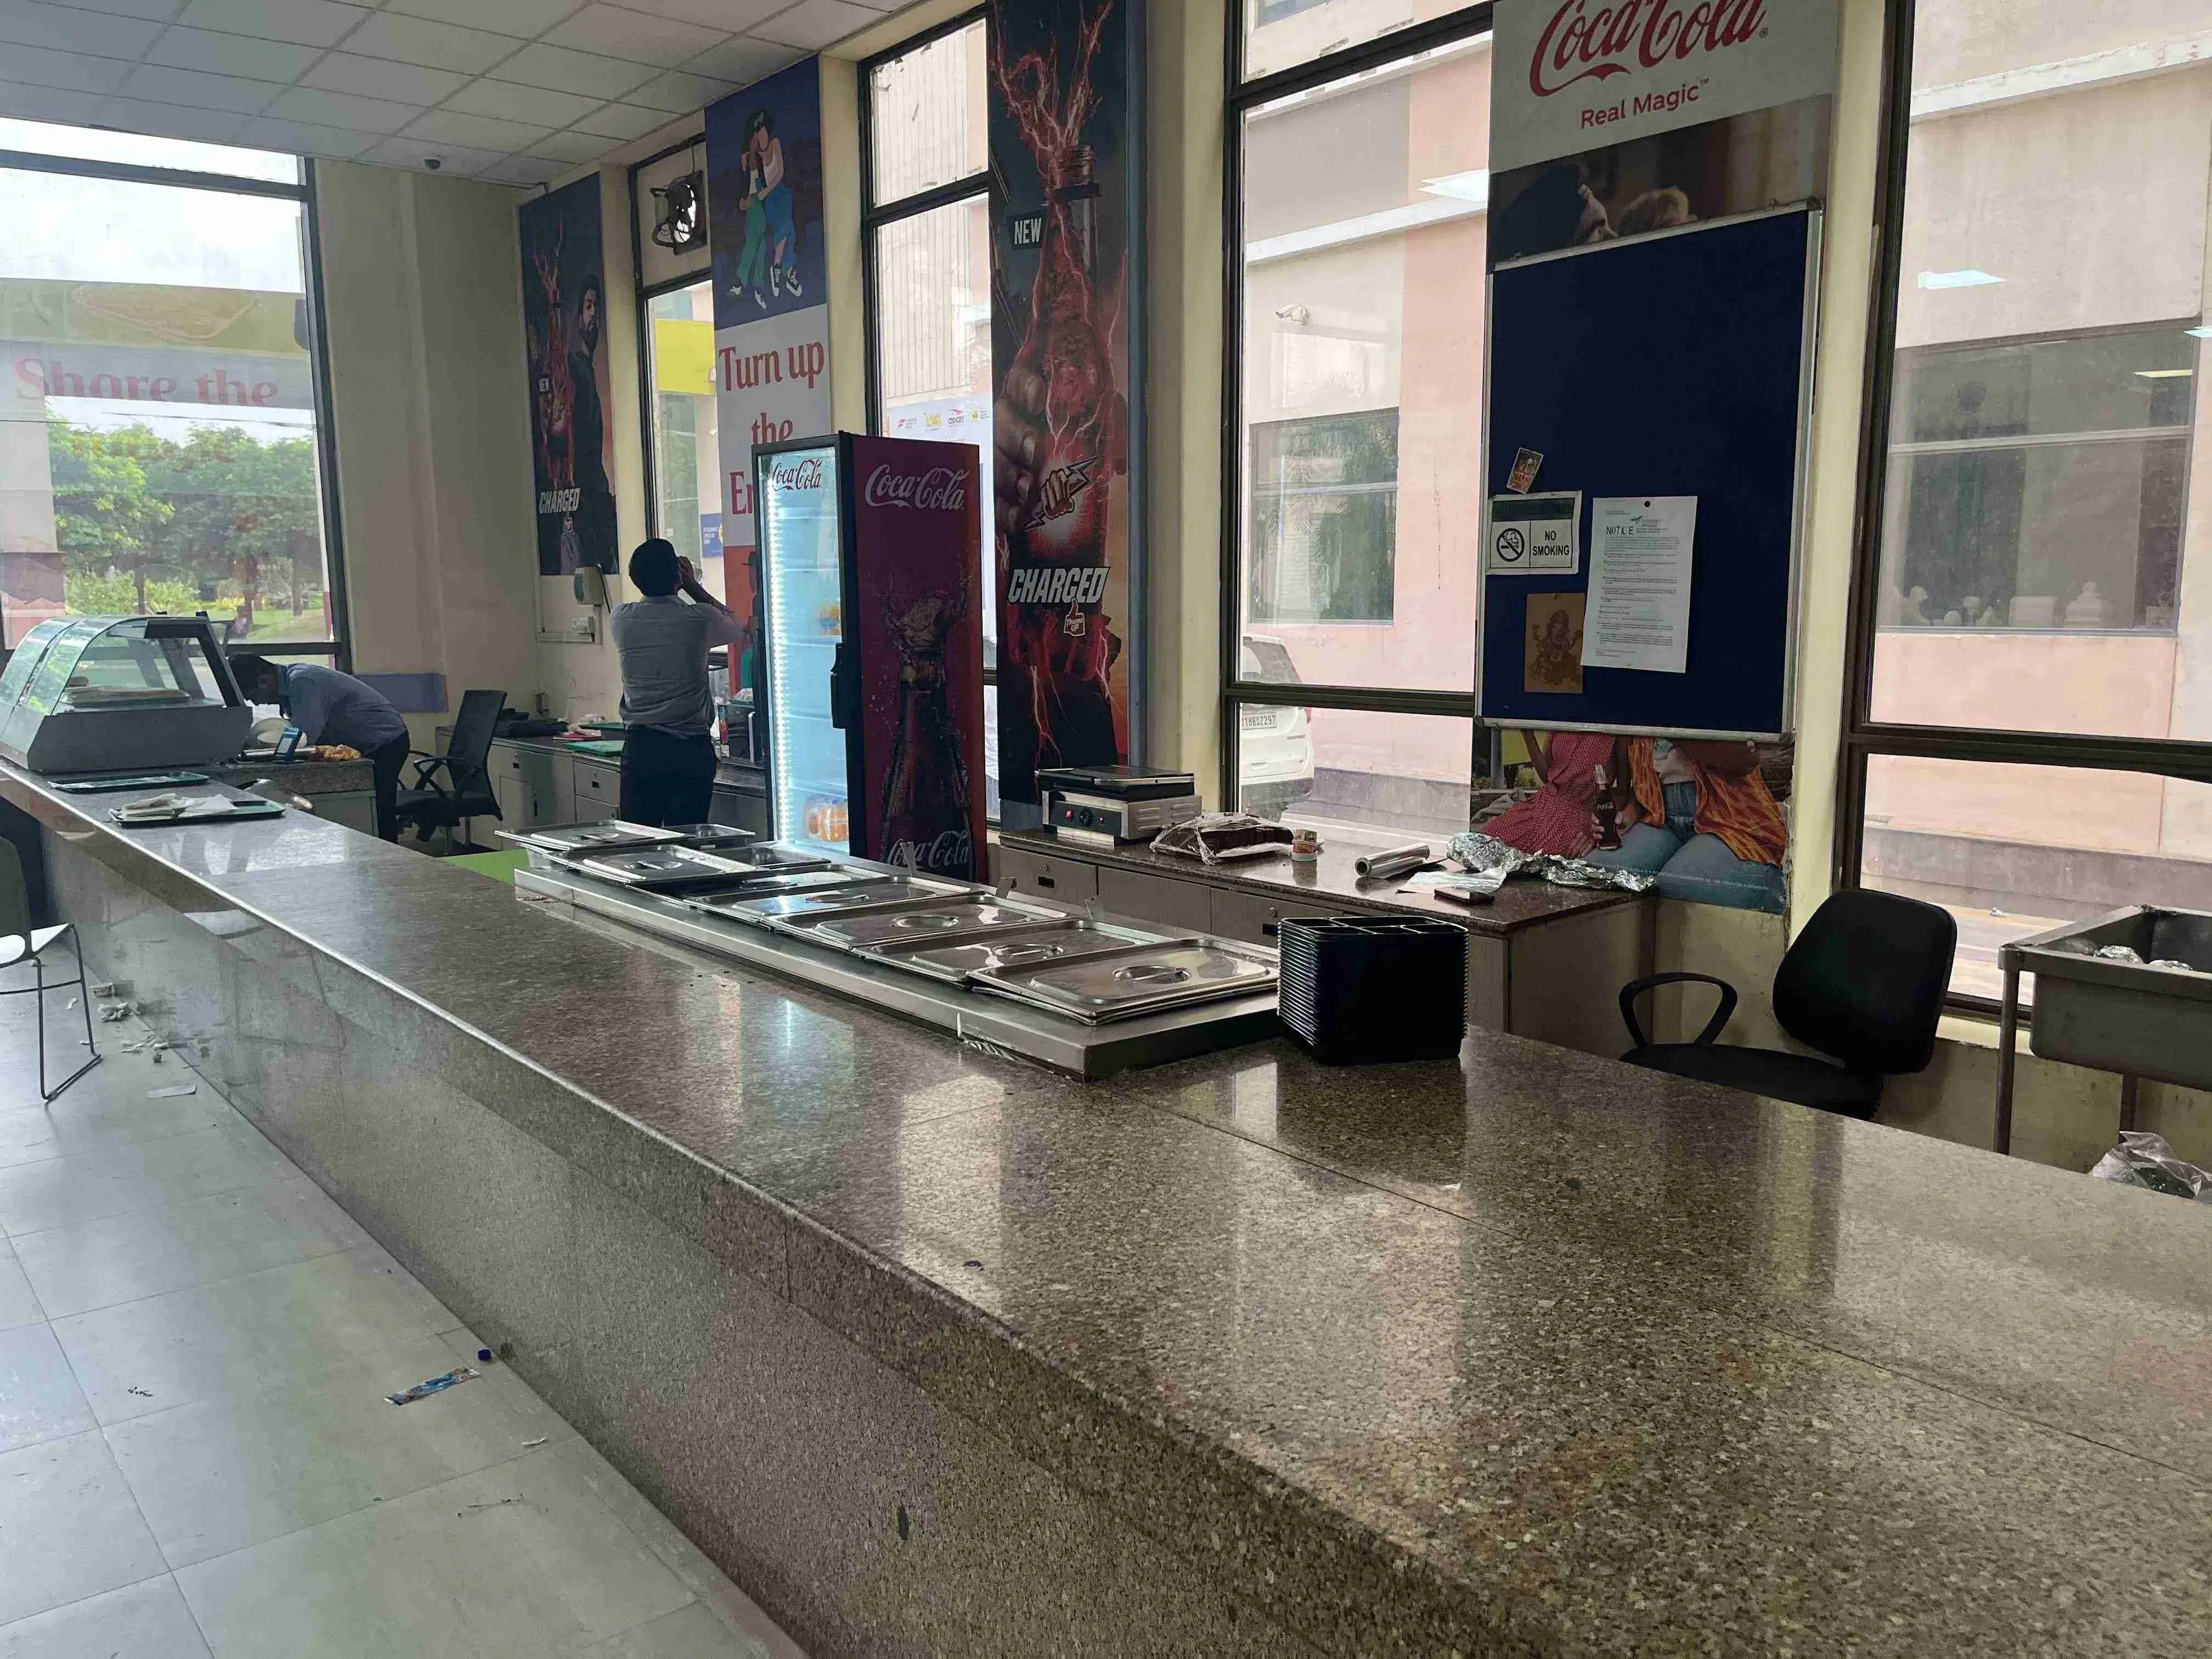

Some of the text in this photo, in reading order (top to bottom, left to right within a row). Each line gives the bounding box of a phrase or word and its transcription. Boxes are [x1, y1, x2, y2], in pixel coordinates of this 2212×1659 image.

[1530, 0, 1766, 97] CocaCola
[1581, 99, 1626, 129] Real
[1014, 218, 1042, 244] NEW
[15, 357, 279, 407] Share the
[719, 342, 824, 391] Turn up
[751, 411, 793, 444] the
[772, 459, 822, 492] Coca-Cola
[865, 464, 970, 510] Coca-Cola
[539, 488, 582, 514] CHARGED
[1532, 545, 1570, 556] SMOKING
[1545, 531, 1556, 540] NO
[1008, 567, 1110, 603] CHARGED
